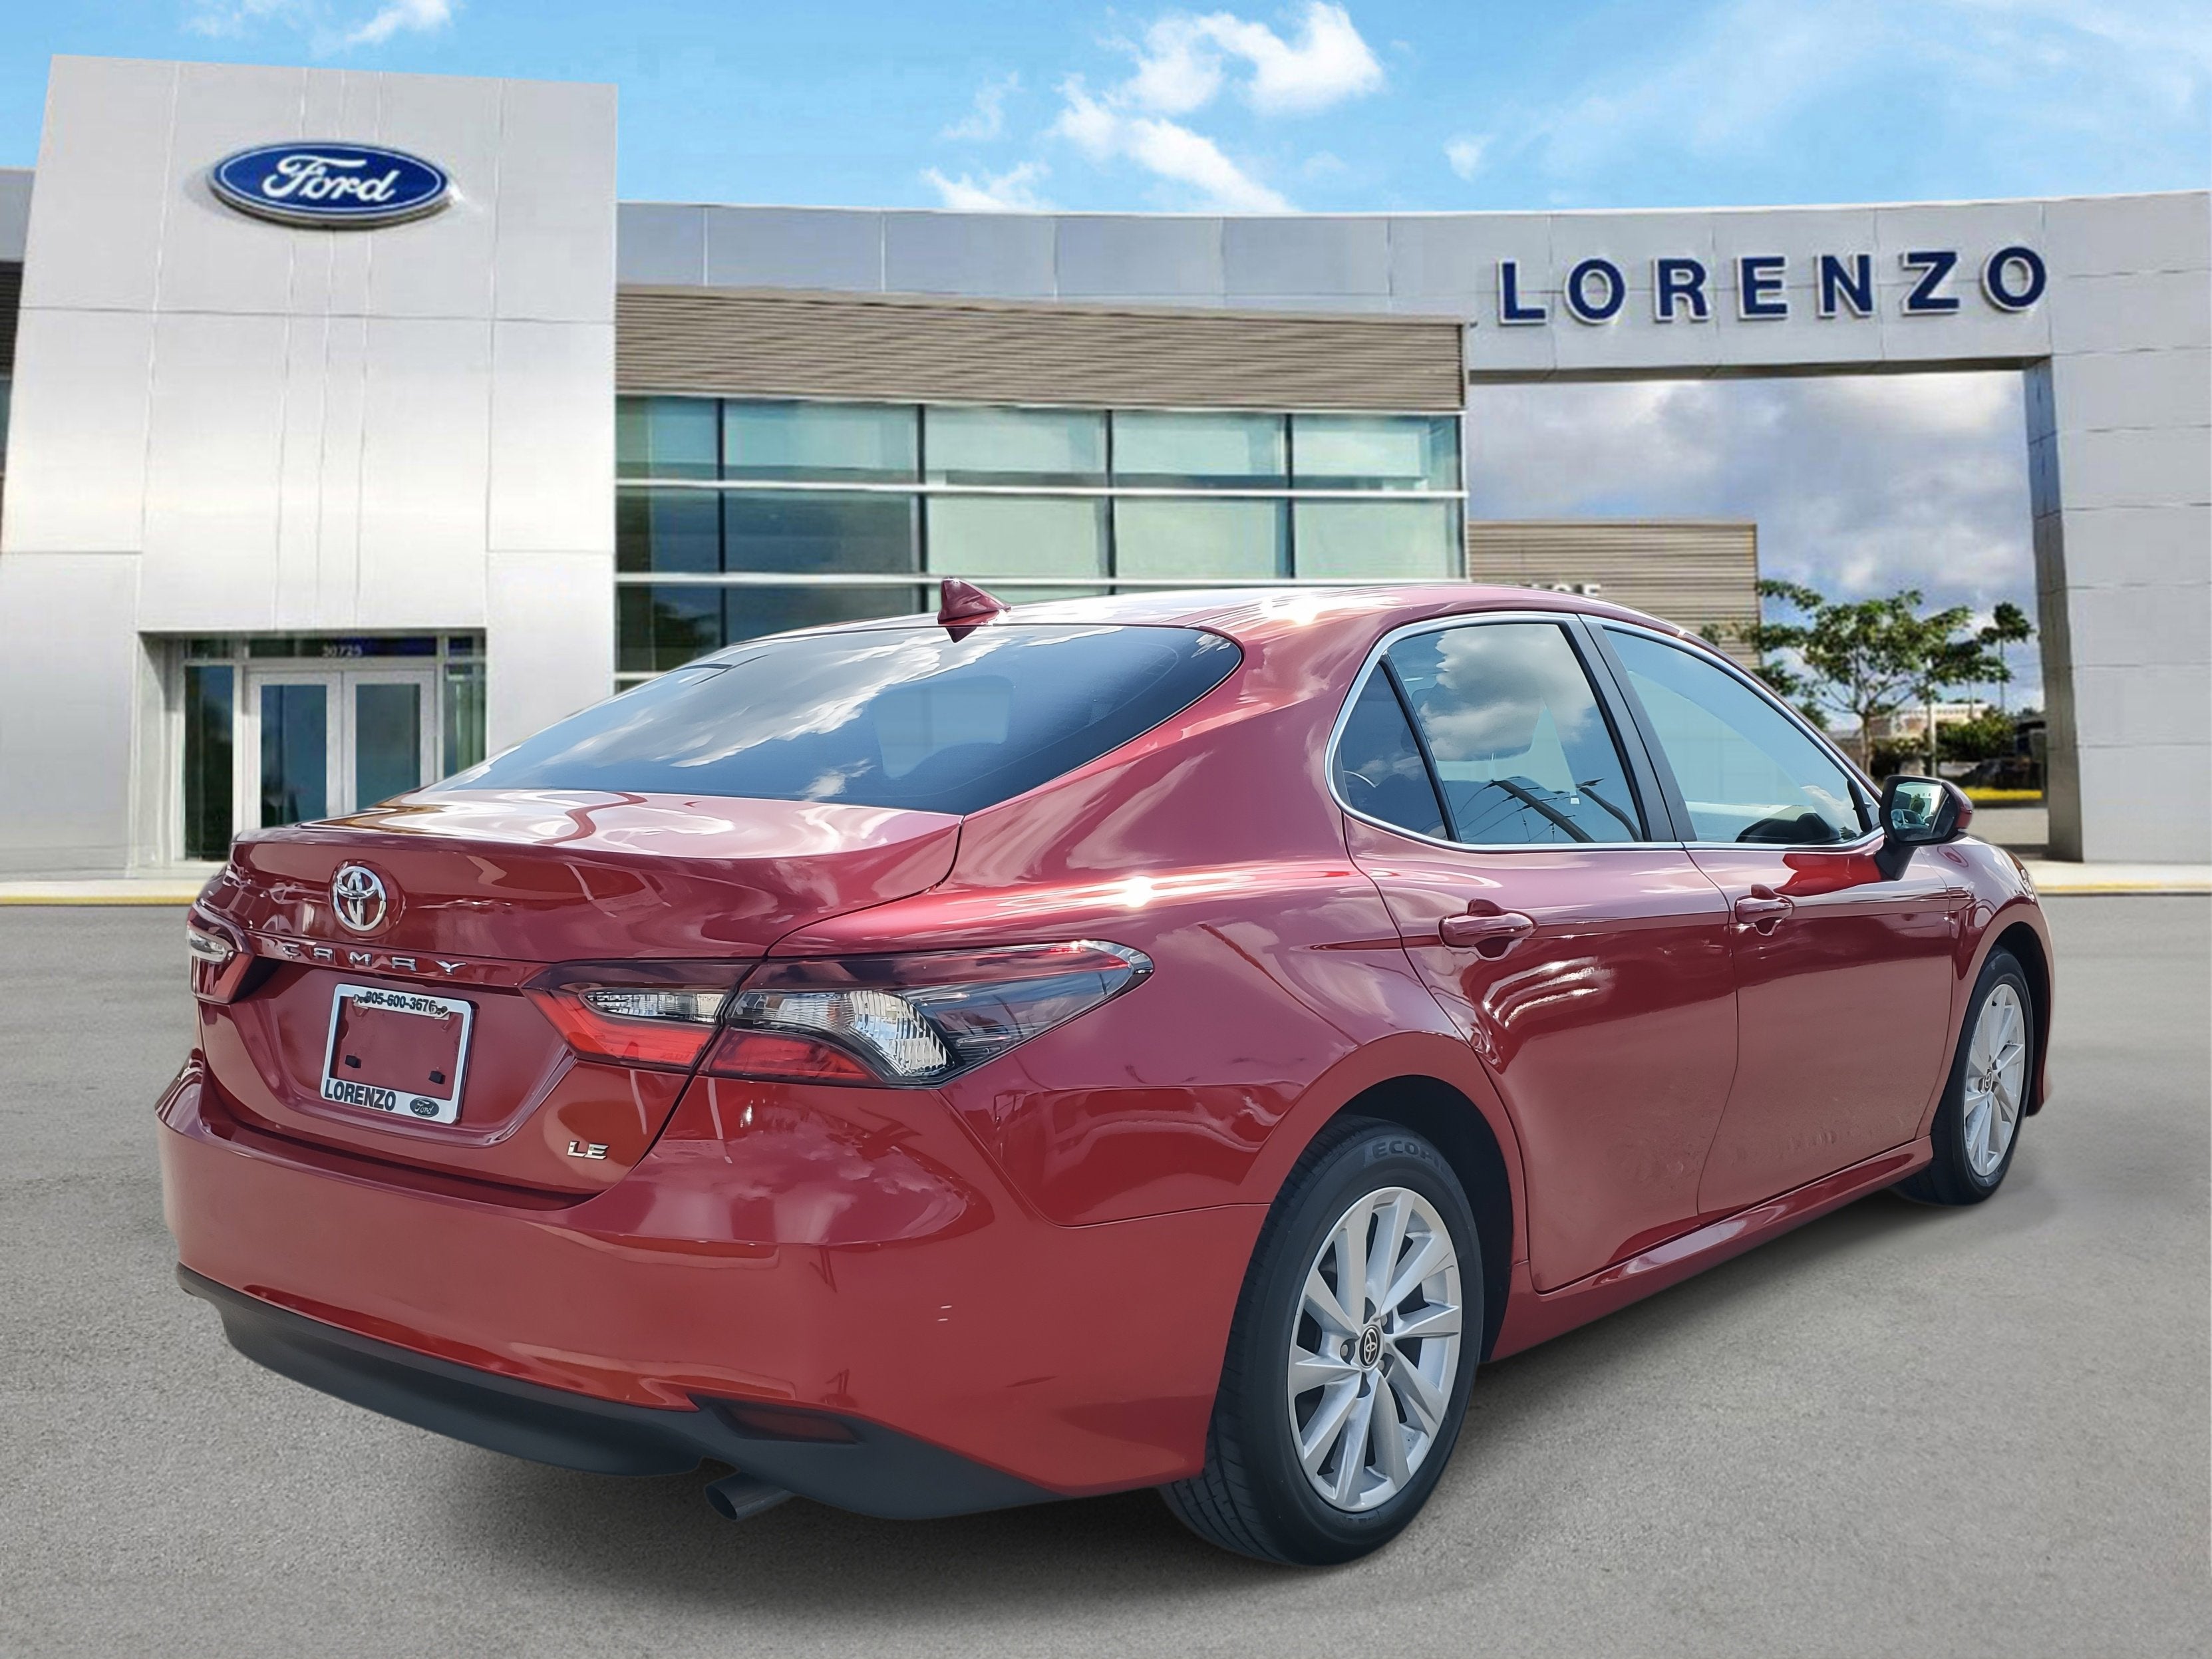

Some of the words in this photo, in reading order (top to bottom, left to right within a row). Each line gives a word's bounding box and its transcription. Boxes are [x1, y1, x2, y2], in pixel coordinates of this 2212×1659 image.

[263, 154, 400, 202] Ford
[1497, 246, 2048, 325] LORENZO
[282, 943, 467, 975] CAMRY
[324, 1079, 396, 1111] LORENZO
[414, 1100, 434, 1114] Ford
[567, 1141, 609, 1159] LE
